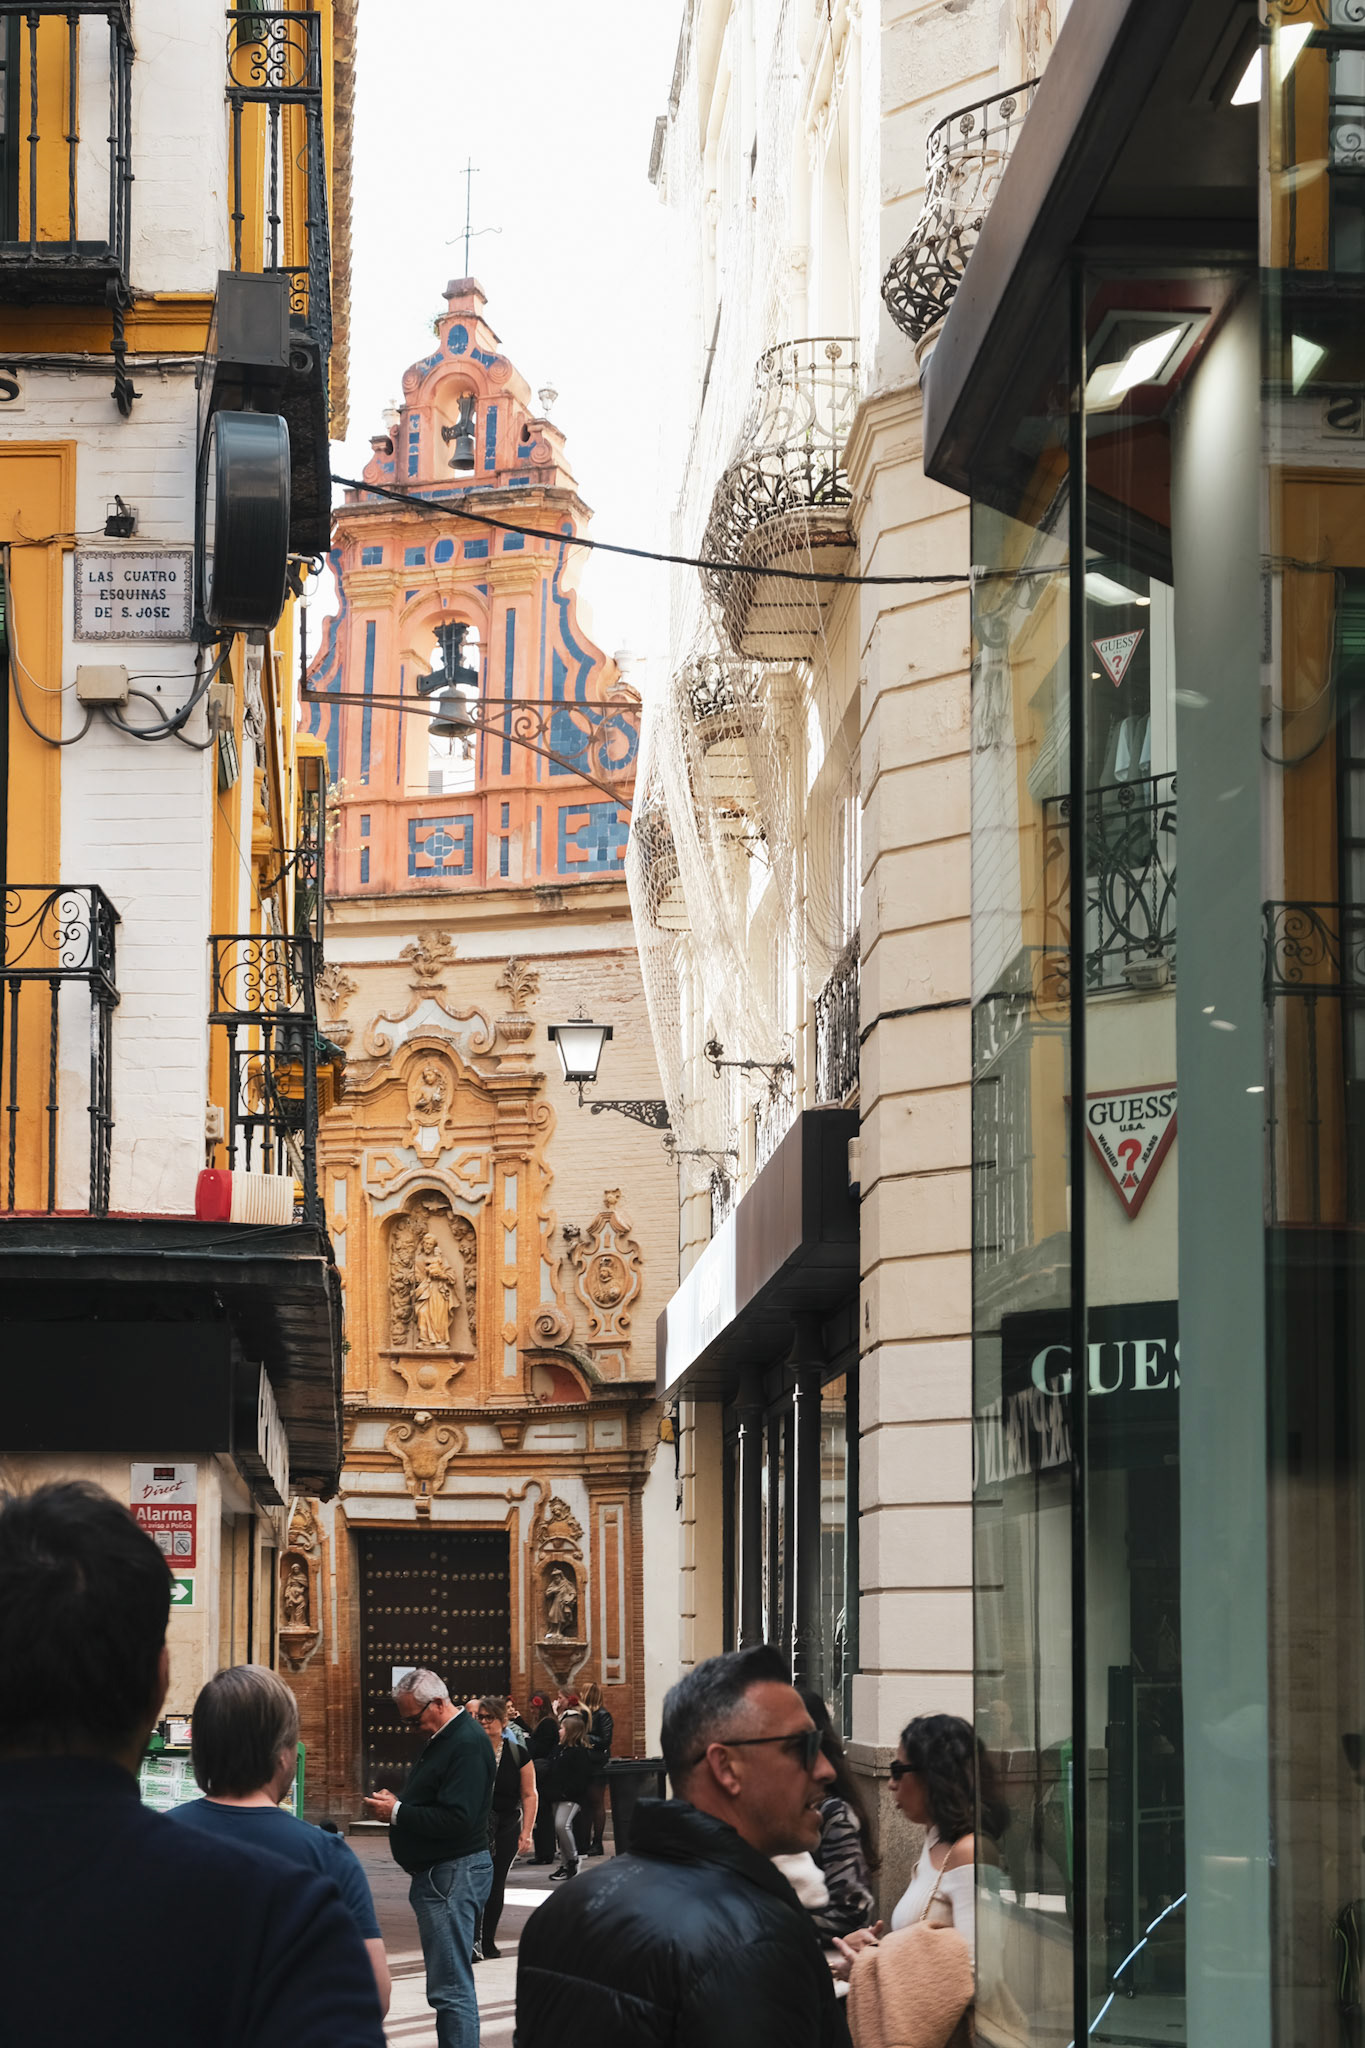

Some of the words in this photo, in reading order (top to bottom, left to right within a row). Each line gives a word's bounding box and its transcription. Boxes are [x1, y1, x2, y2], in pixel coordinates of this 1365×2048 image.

[89, 571, 114, 582] LAS
[124, 571, 177, 582] CUATRO
[100, 589, 166, 600] ESQUINAS
[95, 607, 112, 618] DE
[121, 607, 132, 618] S.
[136, 607, 170, 618] JOSE
[1100, 636, 1134, 653] GUESS
[1120, 1123, 1145, 1132] U.S.A.
[1098, 1134, 1119, 1168] WASHED
[1141, 1134, 1158, 1163] JEANS
[1031, 1339, 1180, 1396] GUE
[142, 1480, 187, 1499] Direct
[136, 1506, 192, 1521] Alarma
